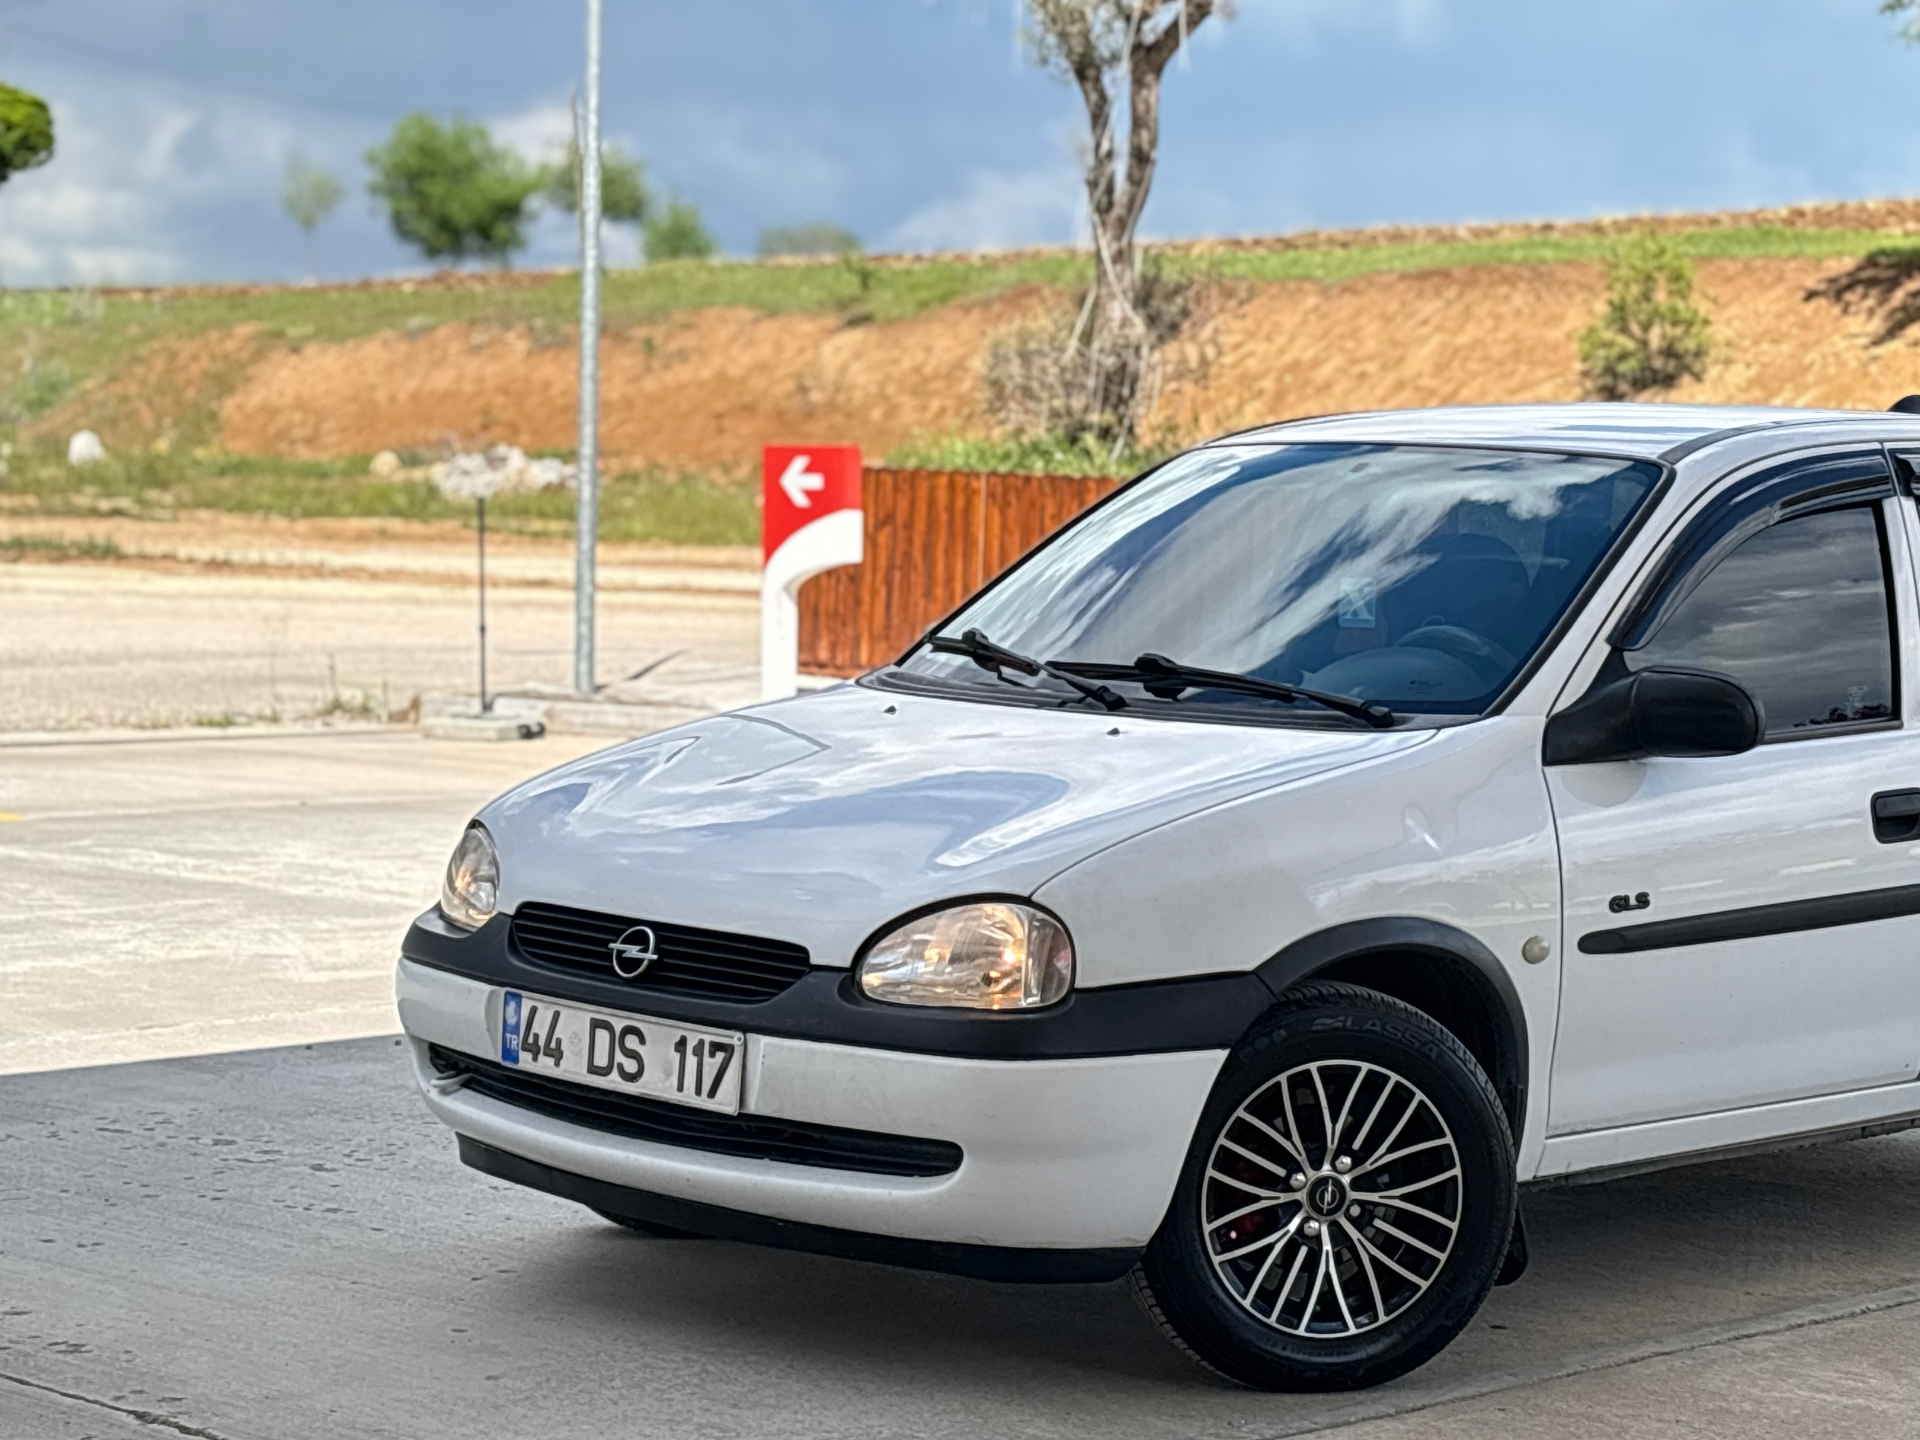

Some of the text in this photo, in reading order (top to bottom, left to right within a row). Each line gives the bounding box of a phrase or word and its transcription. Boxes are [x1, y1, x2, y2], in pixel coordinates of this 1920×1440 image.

[1608, 891, 1651, 914] GLS
[504, 1032, 519, 1051] TR
[520, 1005, 736, 1100] 44 DS 117
[1345, 1015, 1440, 1062] LASSA
